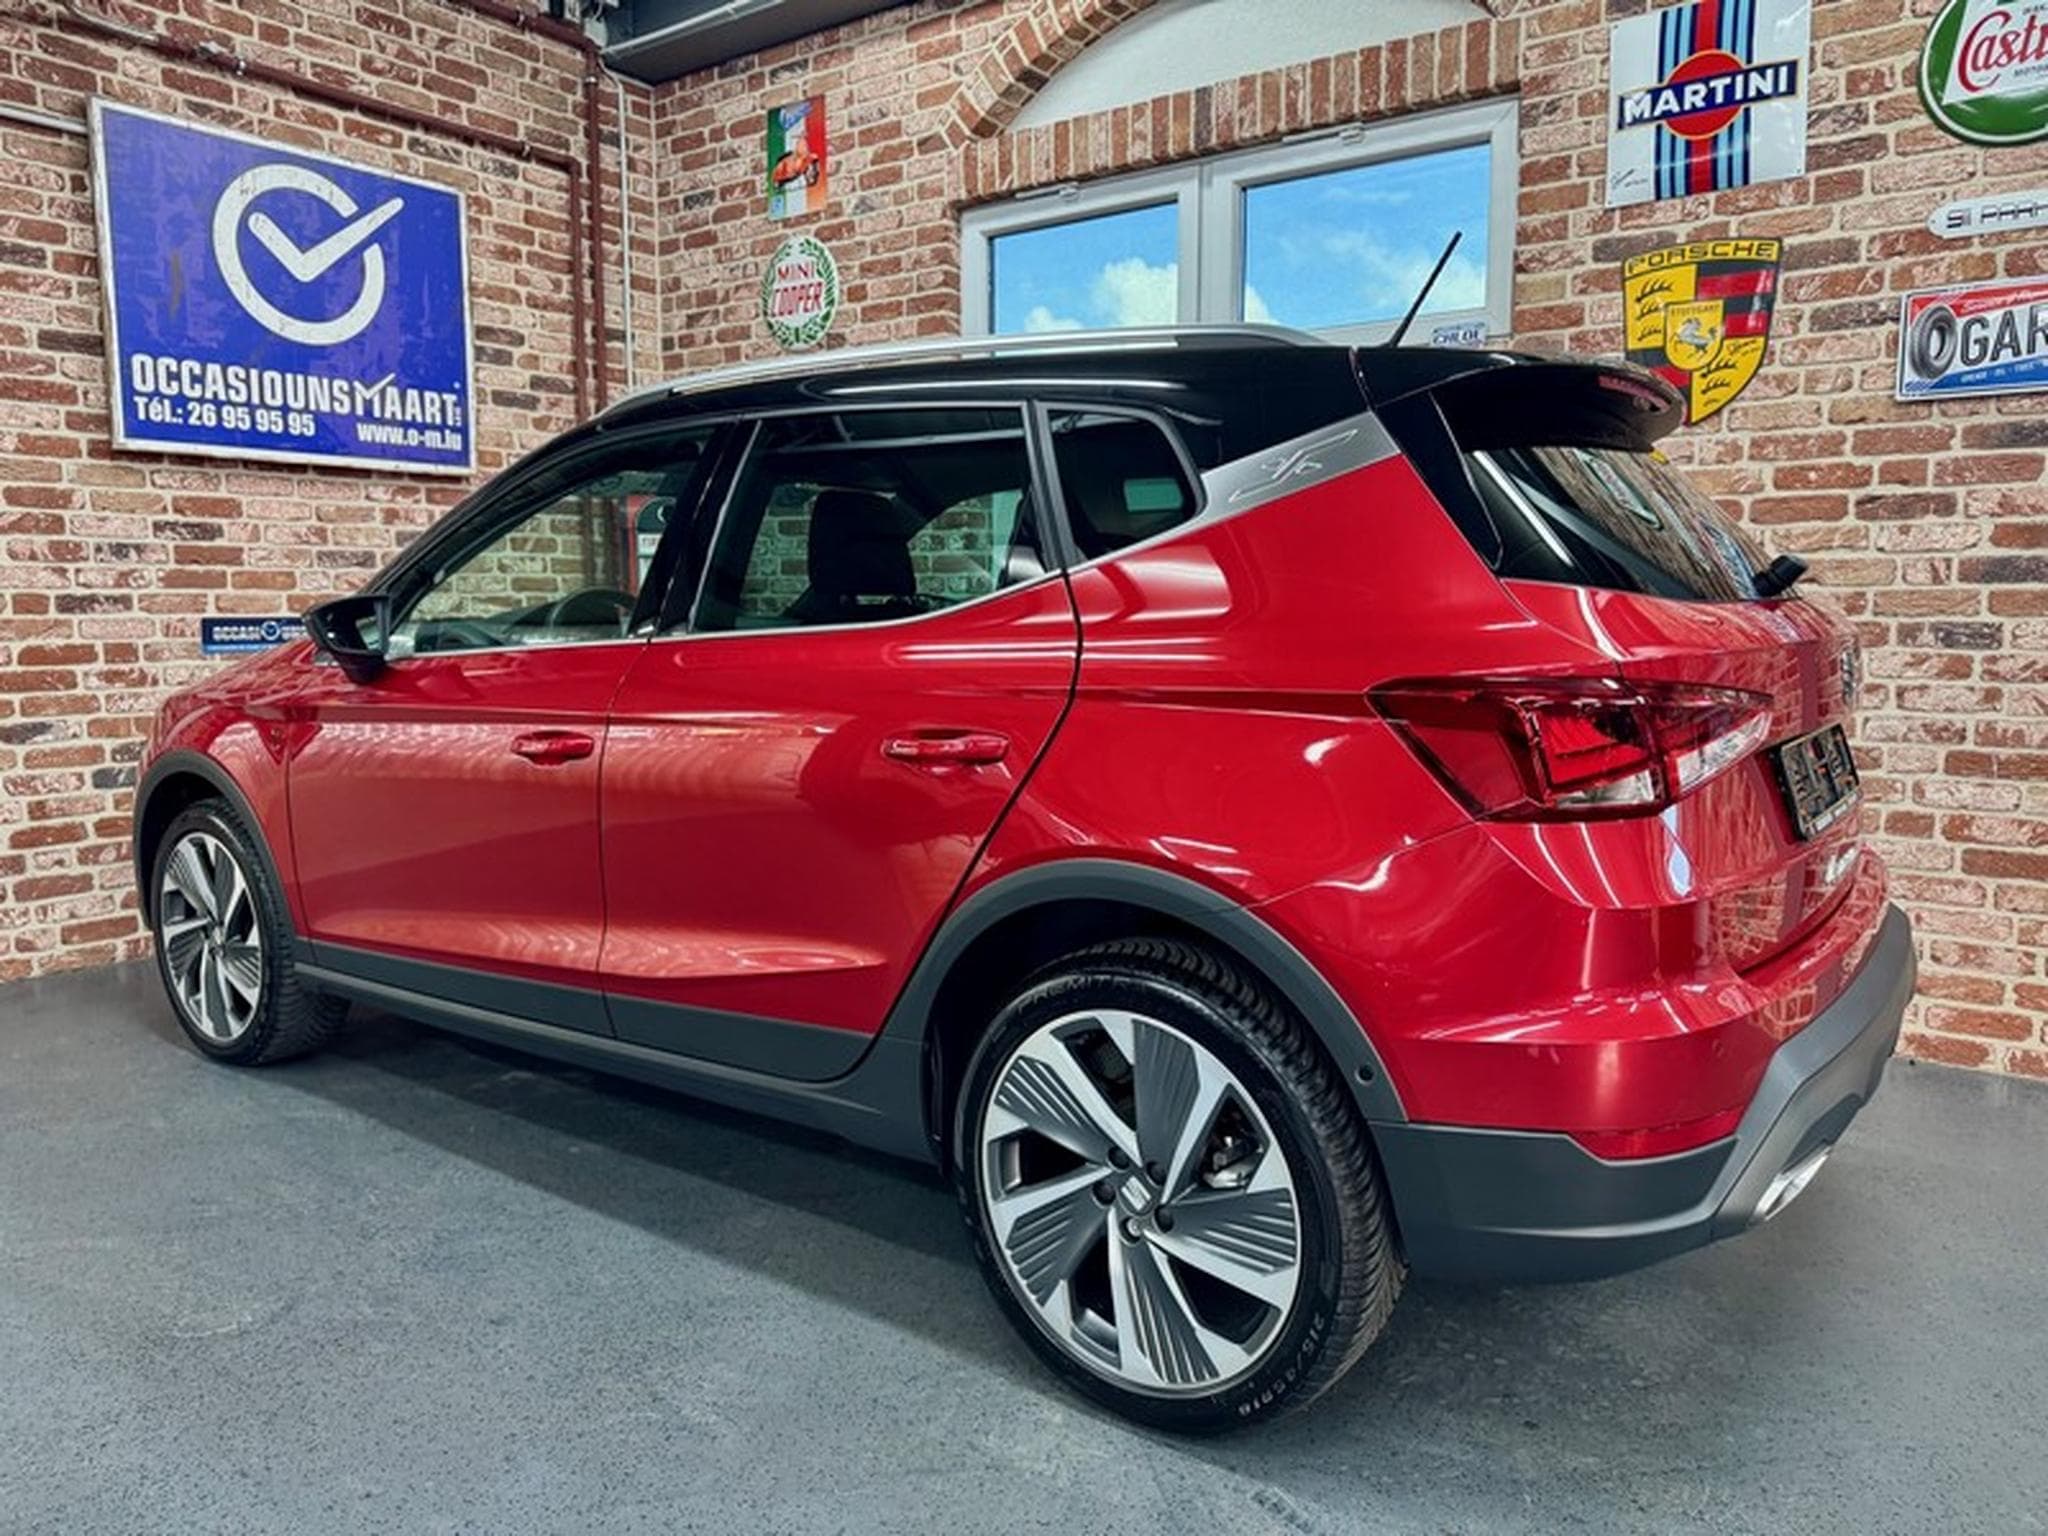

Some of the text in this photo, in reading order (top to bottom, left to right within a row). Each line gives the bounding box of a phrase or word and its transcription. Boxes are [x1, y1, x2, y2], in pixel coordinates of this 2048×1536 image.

[1623, 65, 1788, 124] MARTINI
[778, 261, 815, 281] MINI
[1628, 242, 1775, 274] PORSCHE
[771, 281, 823, 318] COOPER
[187, 401, 217, 428] 26
[222, 404, 251, 431] 95
[255, 408, 284, 435] 95
[288, 412, 316, 437] 95
[356, 422, 462, 451] www.o-m.lu
